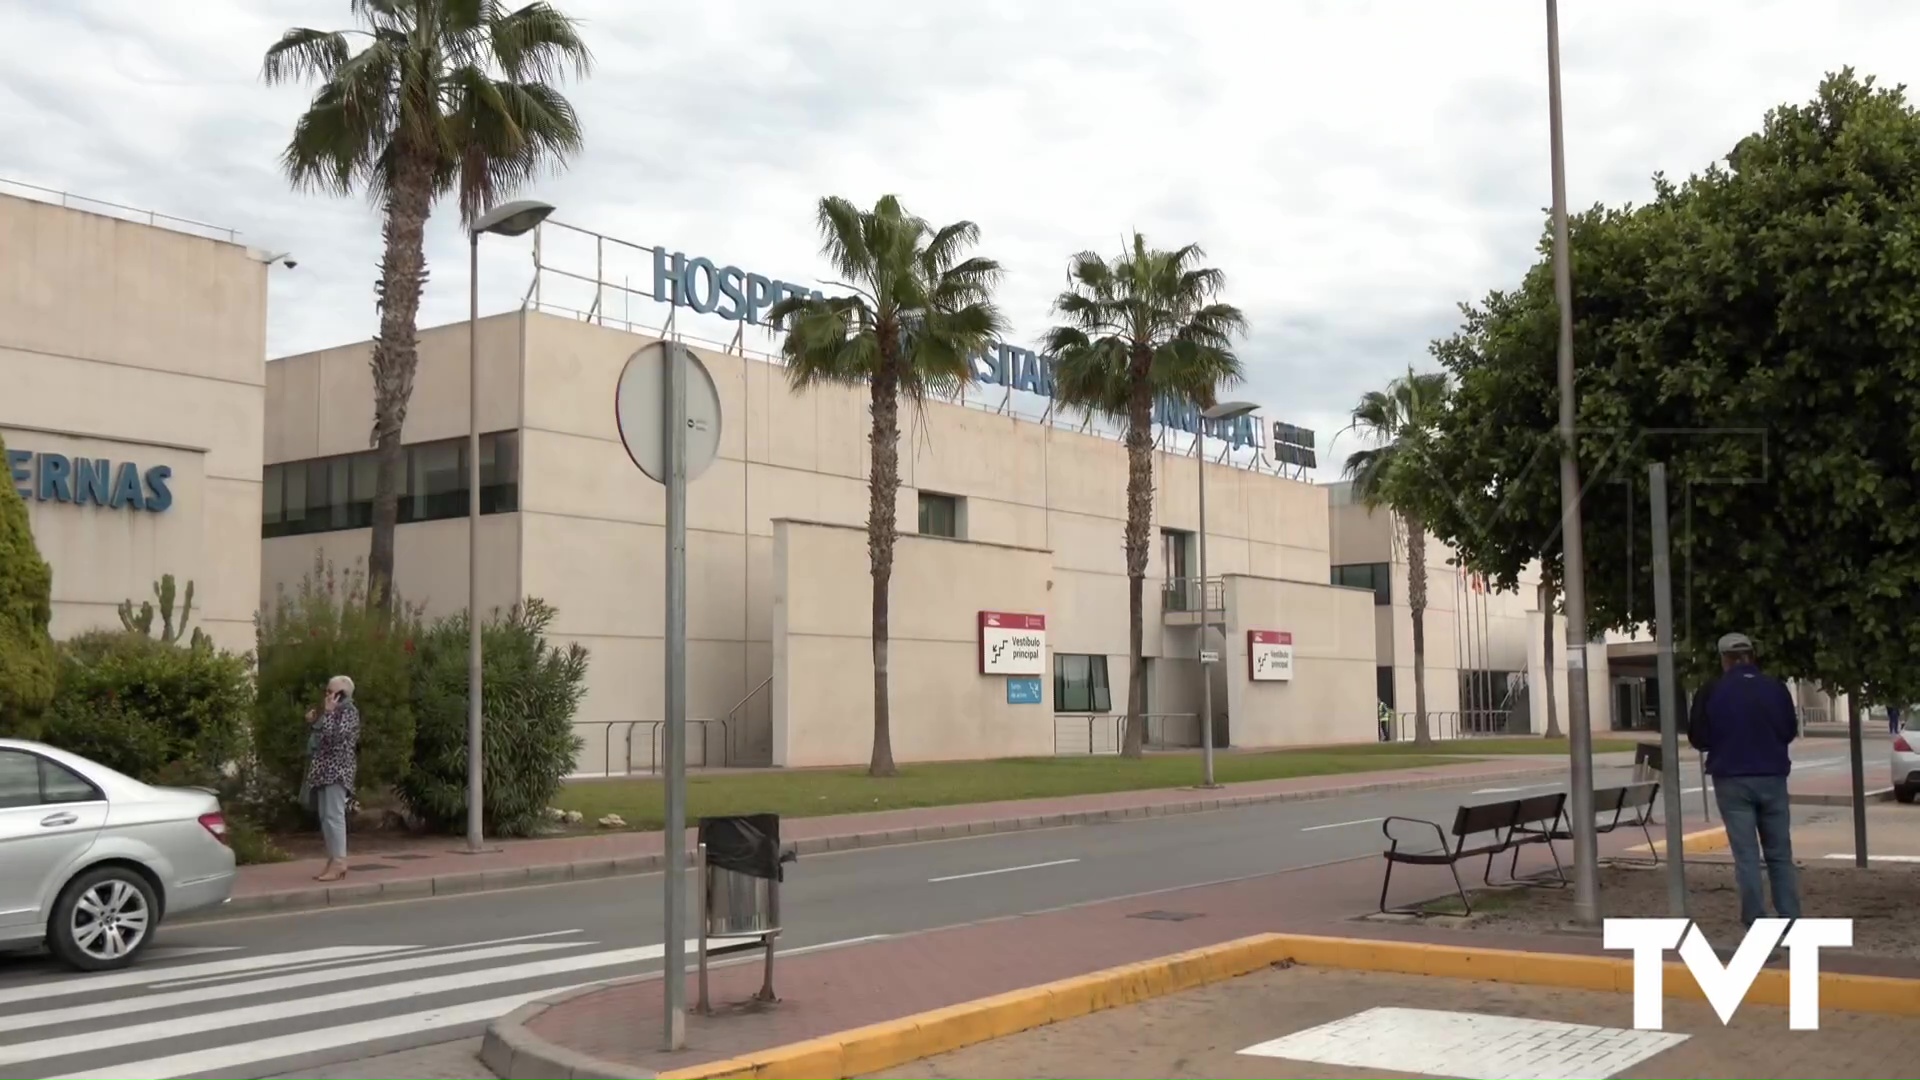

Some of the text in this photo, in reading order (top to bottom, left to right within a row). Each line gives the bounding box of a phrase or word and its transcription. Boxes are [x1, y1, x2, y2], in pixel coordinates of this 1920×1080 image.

[8, 449, 172, 512] ERNAS
[1011, 636, 1040, 647] Vestíbulo
[1012, 649, 1039, 661] principal
